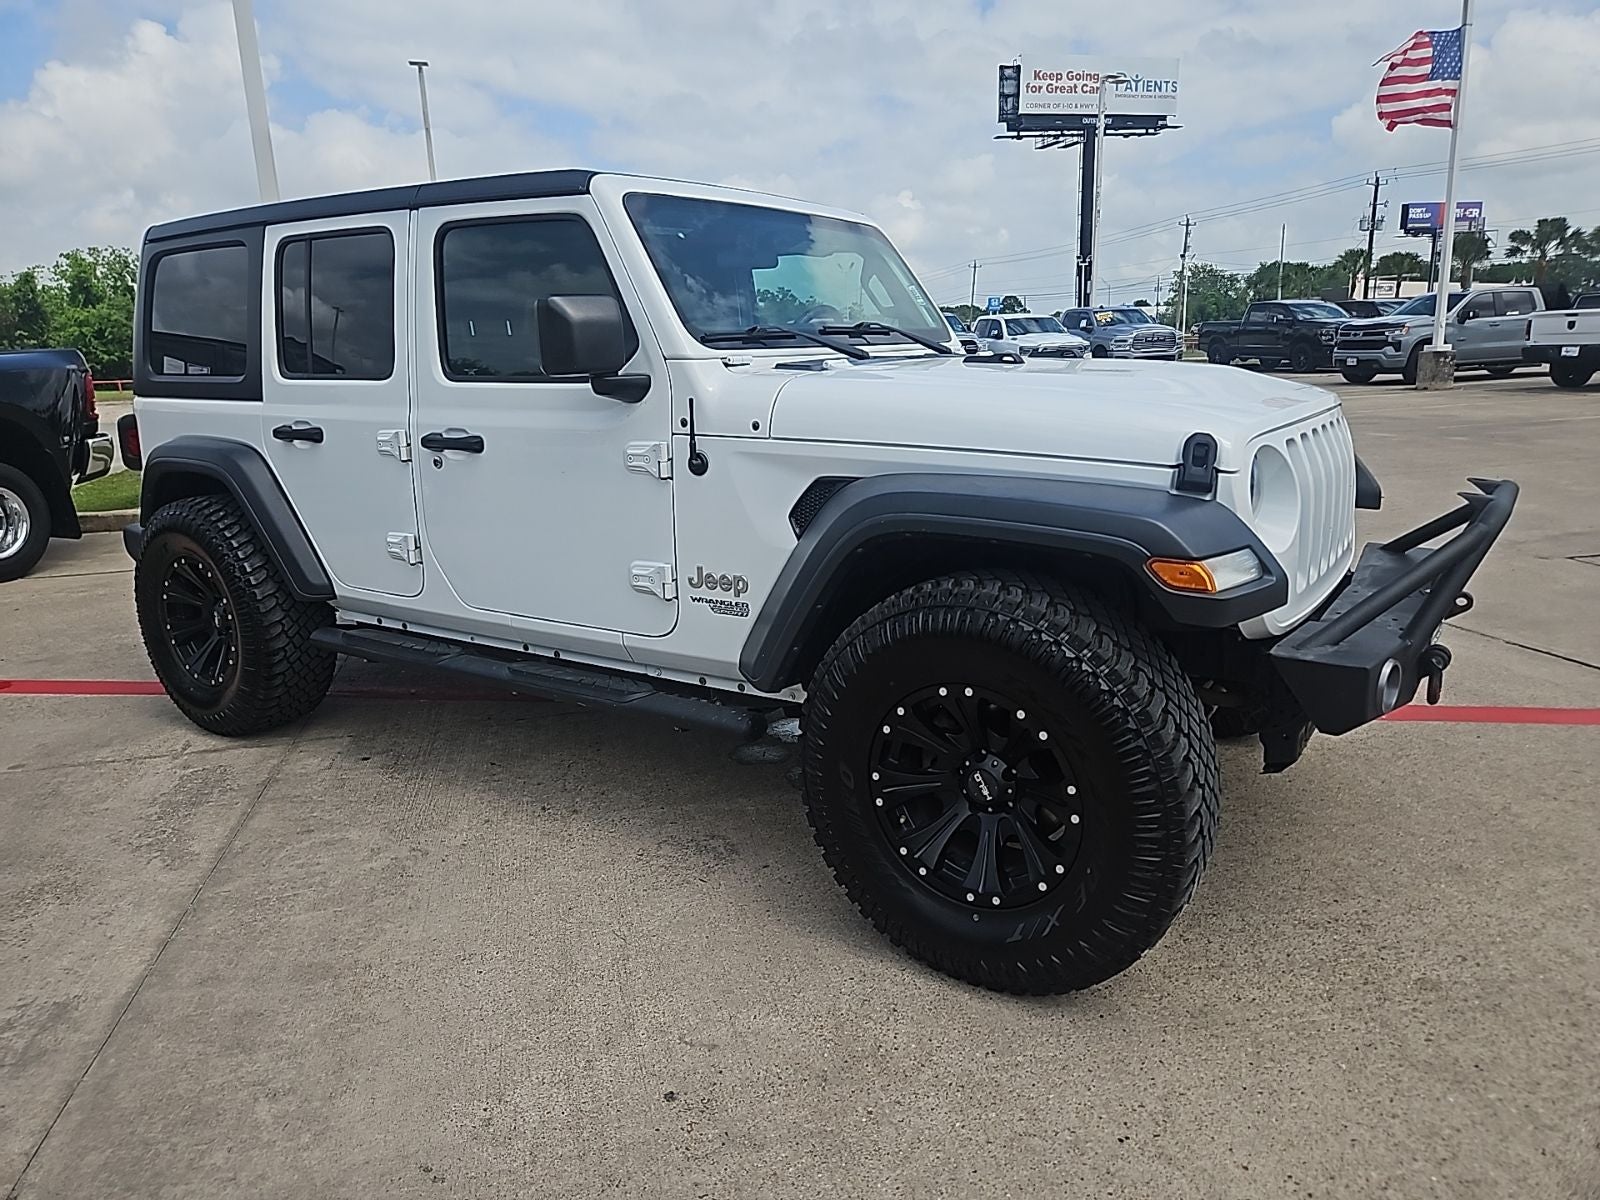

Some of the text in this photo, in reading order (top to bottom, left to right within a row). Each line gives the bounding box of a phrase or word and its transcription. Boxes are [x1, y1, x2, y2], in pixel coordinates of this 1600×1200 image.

[1033, 69, 1100, 84] Keep Going
[1025, 82, 1100, 94] for Great Car
[687, 565, 749, 598] Jeep
[689, 595, 749, 609] WRANGLER
